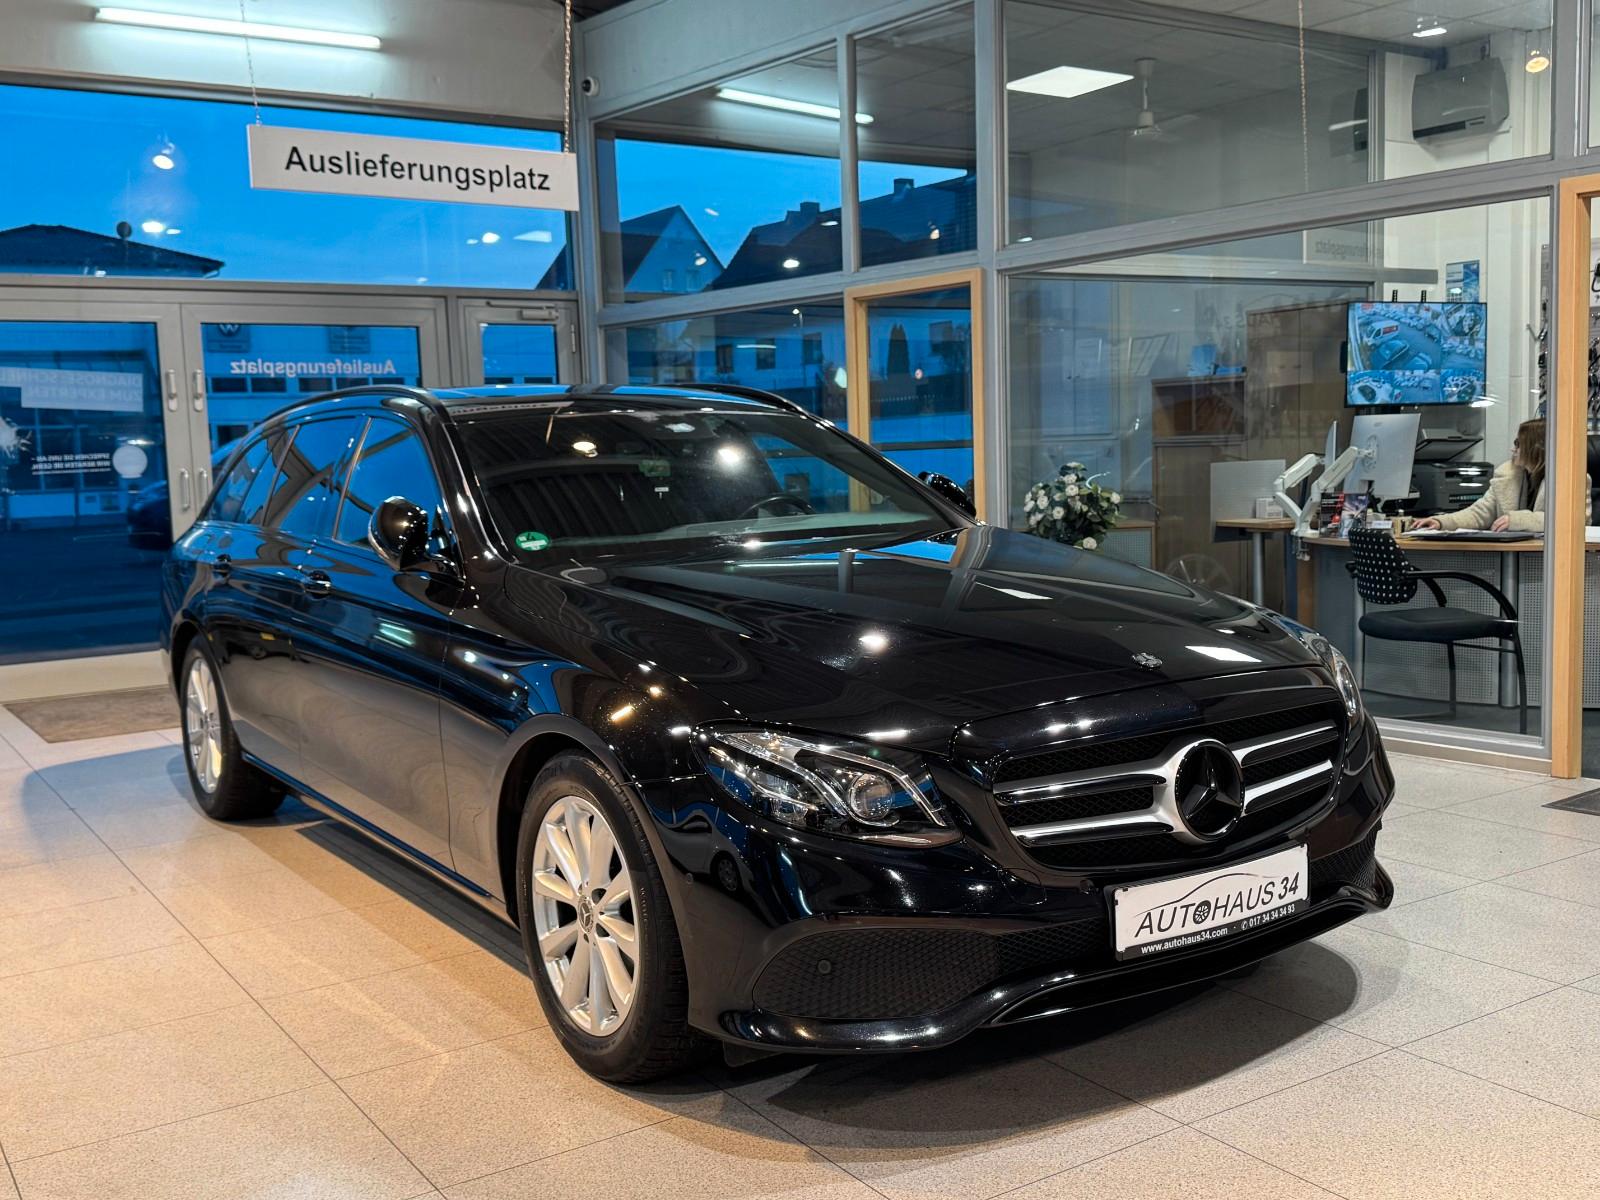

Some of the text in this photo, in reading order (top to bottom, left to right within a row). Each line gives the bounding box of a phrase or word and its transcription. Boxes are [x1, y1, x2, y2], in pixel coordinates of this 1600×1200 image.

[285, 146, 550, 192] Auslieferungsplatz
[1278, 872, 1300, 901] 34
[1141, 903, 1296, 954] www.autohaus34.com 017 34 34 34 93
